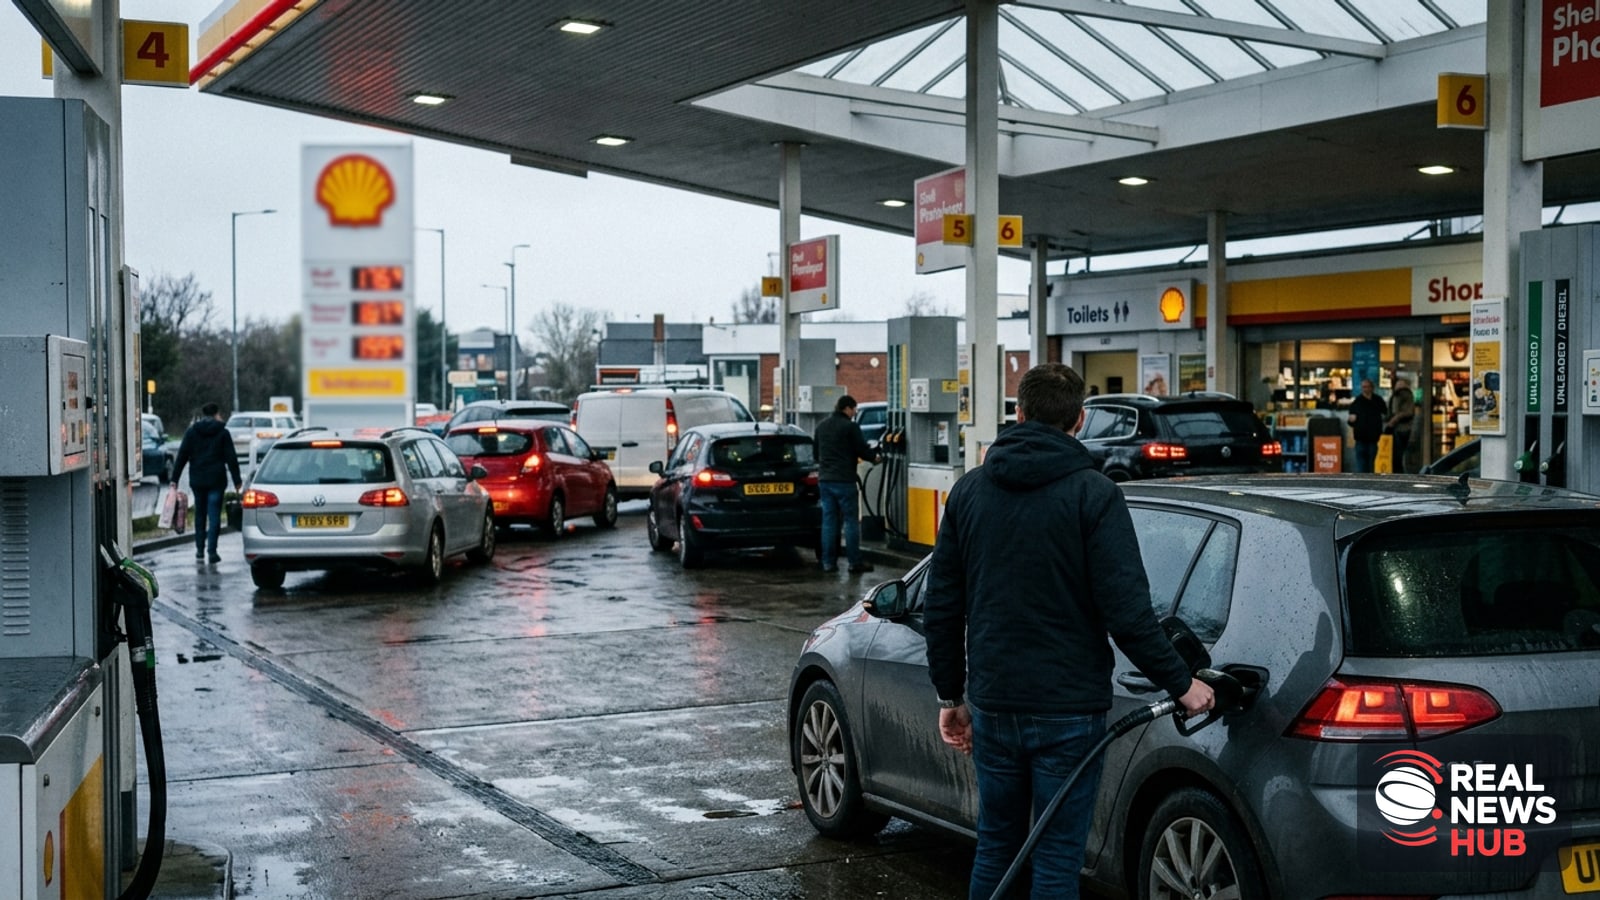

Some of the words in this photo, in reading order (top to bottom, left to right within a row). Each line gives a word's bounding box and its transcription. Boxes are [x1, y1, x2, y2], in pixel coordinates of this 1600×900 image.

[137, 31, 169, 68] 4
[1456, 85, 1477, 116] 6
[952, 220, 965, 238] 5
[1001, 222, 1015, 240] 6
[1067, 304, 1109, 324] Toilets
[1574, 849, 1600, 884] U
